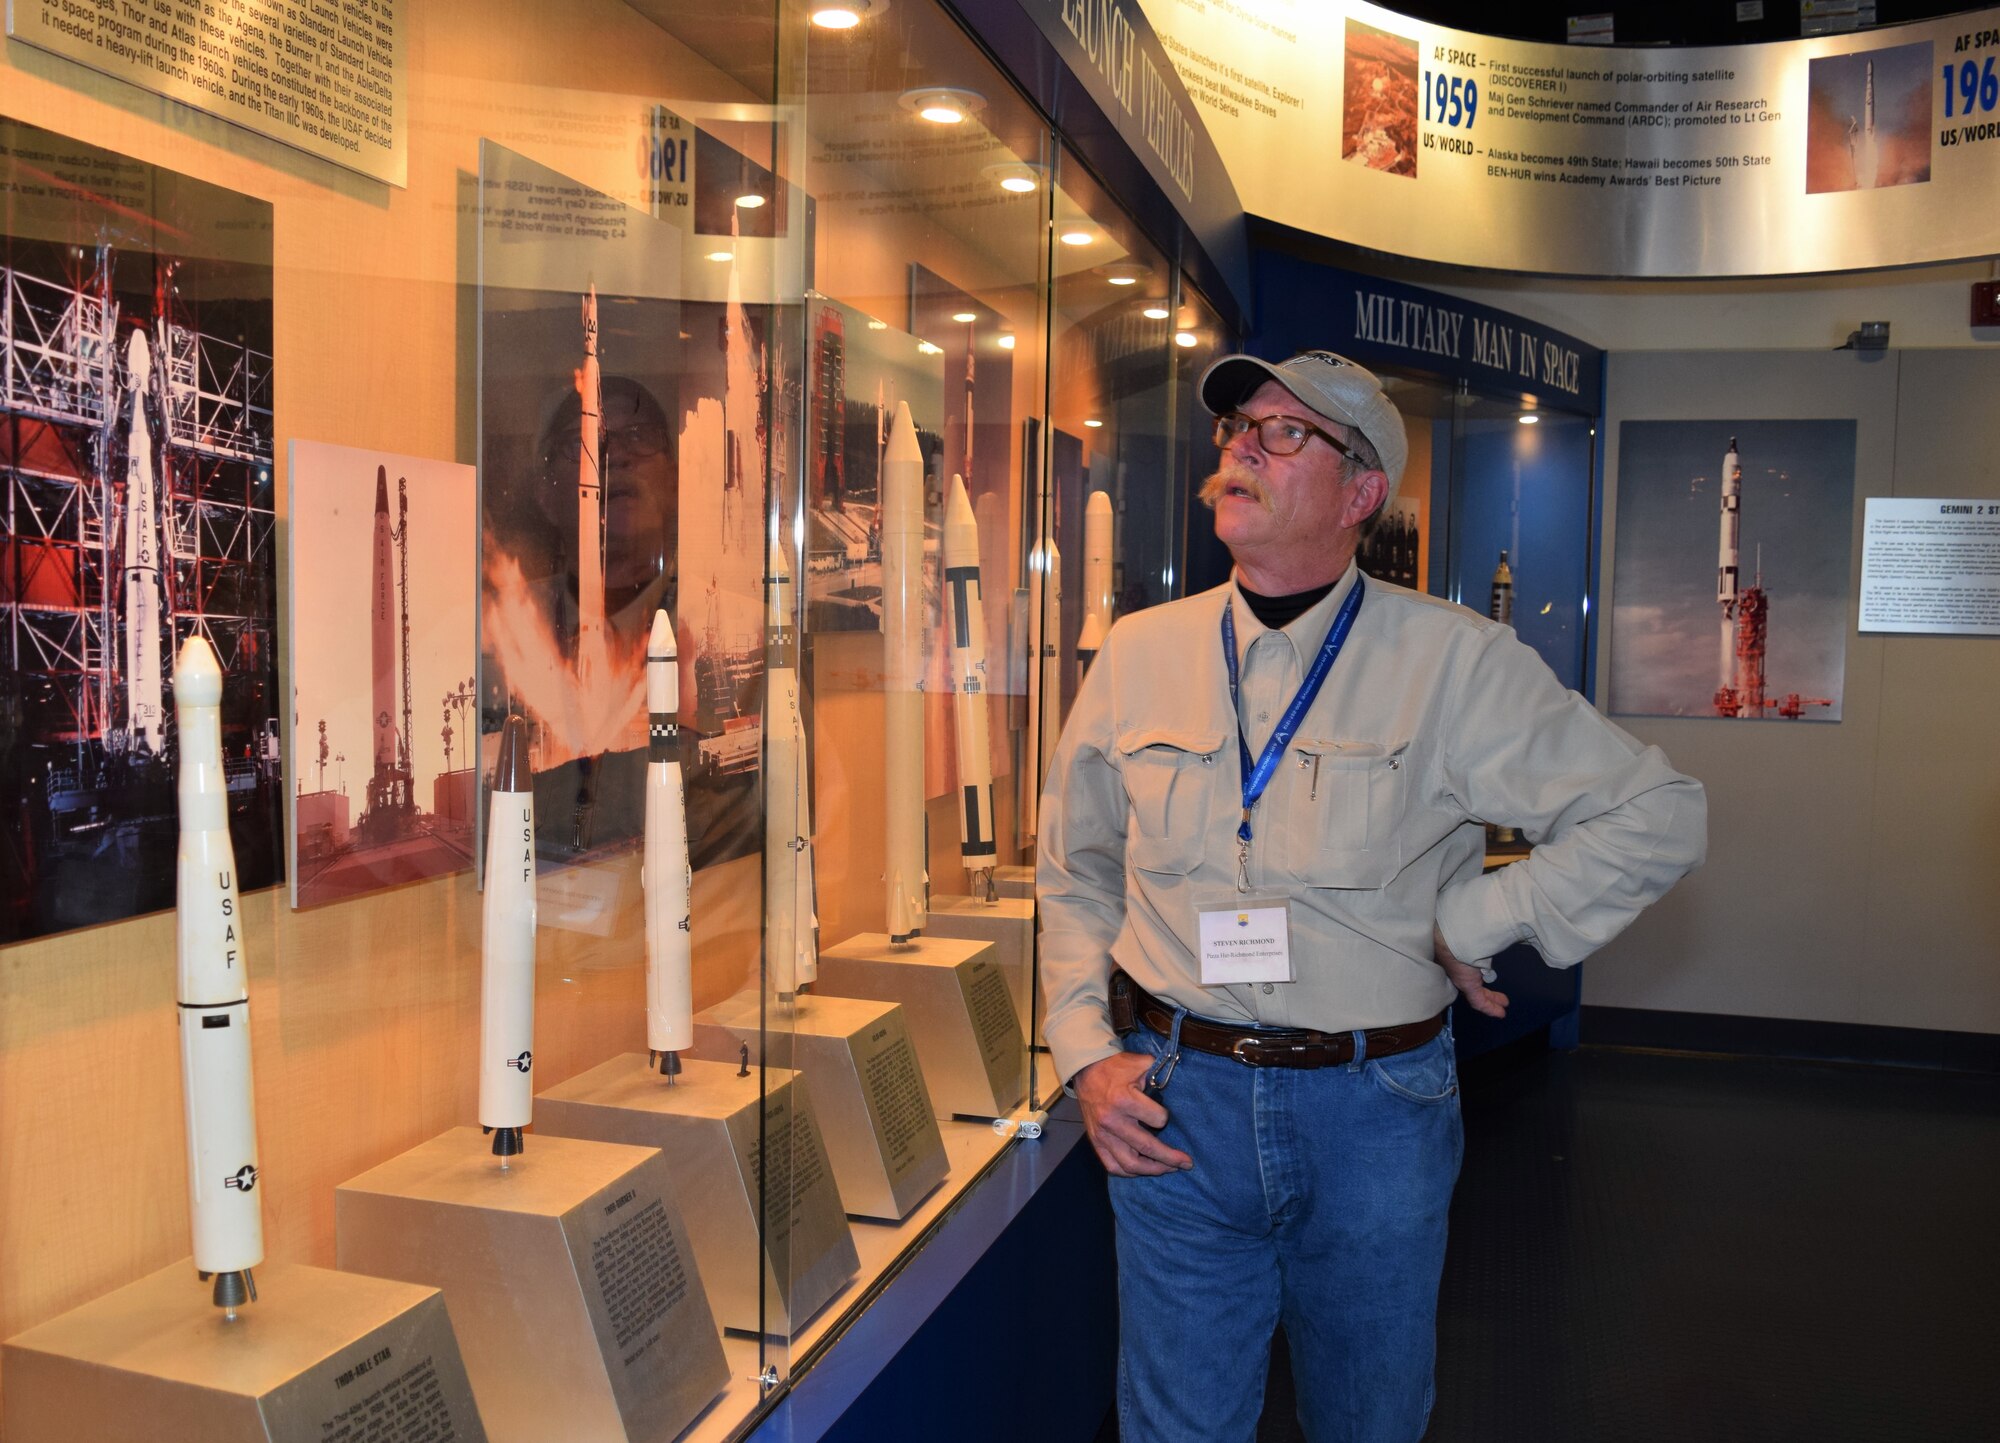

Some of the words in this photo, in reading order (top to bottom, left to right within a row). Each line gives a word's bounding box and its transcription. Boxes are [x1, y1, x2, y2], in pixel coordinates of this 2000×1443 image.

[121, 2, 145, 24] Thor
[149, 16, 167, 34] and
[171, 24, 195, 46] Atlas
[199, 36, 229, 61] launch
[233, 53, 268, 78] vehicles
[271, 70, 317, 99] constituted
[319, 92, 332, 106] the
[334, 97, 369, 122] backbone
[372, 111, 379, 125] of
[381, 115, 392, 132] the
[153, 2, 172, 16] use
[175, 9, 196, 27] with
[200, 18, 225, 40] these
[229, 33, 267, 60] vehicles.
[275, 52, 311, 79] Together
[314, 72, 331, 88] with
[334, 79, 351, 97] their
[354, 91, 392, 117] associated
[204, 3, 215, 17] as
[218, 8, 232, 25] the
[236, 17, 266, 43] Agena,
[269, 32, 282, 48] the
[285, 39, 312, 63] Burner
[326, 60, 339, 77] and
[342, 66, 353, 82] the
[357, 75, 392, 100] Able/Delta
[232, 0, 245, 13] the
[249, 8, 279, 29] several
[283, 24, 316, 47] varieties
[320, 39, 328, 53] of
[331, 44, 363, 70] Standard
[367, 65, 392, 84] Launch
[287, 8, 296, 20] as
[300, 11, 334, 39] Standard
[338, 32, 369, 53] Launch
[367, 47, 392, 68] Vehicle
[1434, 46, 1445, 61] AF
[1448, 49, 1477, 68] SPACE
[1955, 35, 1971, 53] AF
[42, 9, 49, 25] it
[53, 16, 93, 43] needed
[96, 34, 103, 46] a
[106, 37, 153, 67] heavy-lift
[156, 57, 188, 82] launch
[192, 73, 226, 100] vehicle,
[229, 89, 245, 109] and
[248, 96, 261, 112] the
[264, 101, 284, 122] Titan
[287, 111, 300, 128] IIIC
[303, 120, 317, 136] was
[320, 125, 360, 152] developed.
[62, 3, 94, 22] space
[99, 14, 142, 43] program
[145, 33, 177, 60] during
[180, 48, 195, 65] the
[198, 55, 227, 79] 1960s.
[232, 69, 261, 96] During
[263, 82, 276, 99] the
[278, 92, 299, 113] early
[301, 100, 326, 121] 1960s,
[328, 111, 340, 127] the
[342, 117, 363, 136] USAF
[365, 128, 392, 149] decided
[1168, 35, 1188, 57] States
[1189, 47, 1218, 72] launches
[1219, 62, 1228, 77] it's
[1230, 67, 1243, 84] first
[1244, 75, 1271, 97] satellite,
[1272, 86, 1300, 109] Explorer
[1177, 61, 1203, 86] Yankees
[1205, 75, 1219, 93] beat
[1220, 82, 1253, 109] Milwaukee
[1254, 98, 1277, 118] Braves
[1425, 70, 1478, 129] 1959
[1489, 60, 1510, 73] First
[1512, 64, 1564, 79] successful
[1566, 69, 1600, 81] launch
[1602, 71, 1613, 82] of
[1616, 70, 1688, 84] polar-orbiting
[1691, 69, 1735, 82] satellite
[1489, 74, 1557, 92] (DISCOVERER
[1558, 82, 1567, 95] I)
[1943, 56, 1998, 118] 196
[1061, 0, 1135, 117] LAUNCH
[1141, 48, 1194, 203] VEHICLES
[1199, 89, 1218, 108] World
[1219, 100, 1239, 118] Series
[1488, 91, 1504, 105] Maj
[1506, 94, 1526, 105] Gen
[1527, 96, 1574, 110] Schriever
[1576, 101, 1611, 113] named
[1615, 102, 1678, 113] Commander
[1682, 101, 1693, 112] of
[1696, 101, 1712, 112] Air
[1715, 99, 1768, 111] Research
[1488, 106, 1505, 116] and
[1507, 107, 1570, 125] Development
[1572, 113, 1625, 126] Command
[1628, 115, 1671, 128] (ARDC);
[1674, 113, 1727, 128] promoted
[1730, 113, 1741, 124] to
[1744, 112, 1755, 123] Lt
[1759, 111, 1781, 123] Gen
[1424, 132, 1473, 155] US/WORLD
[1488, 148, 1518, 161] Alaska
[1520, 152, 1564, 166] becomes
[1567, 156, 1588, 167] 49th
[1591, 157, 1622, 170] State;
[1625, 158, 1660, 169] Hawaii
[1663, 157, 1712, 169] becomes
[1715, 156, 1739, 167] 50th
[1742, 155, 1771, 166] State
[1487, 165, 1531, 180] BEN-HUR
[1534, 172, 1556, 182] wins
[1559, 172, 1606, 187] Academy
[1655, 175, 1679, 186] Best
[1682, 175, 1722, 186] Picture
[1354, 290, 1464, 359] MILITARY
[1472, 318, 1512, 373] MAN
[1519, 332, 1537, 380] IN
[1543, 341, 1580, 395] SPACE
[1940, 505, 1973, 515] GEMINI
[1977, 505, 1984, 515] 2
[523, 808, 532, 883] USAF
[218, 872, 238, 969] USAF
[1239, 938, 1275, 946] RICHMOND
[334, 1358, 373, 1390] THOR-ABLE
[373, 1347, 392, 1366] STAR
